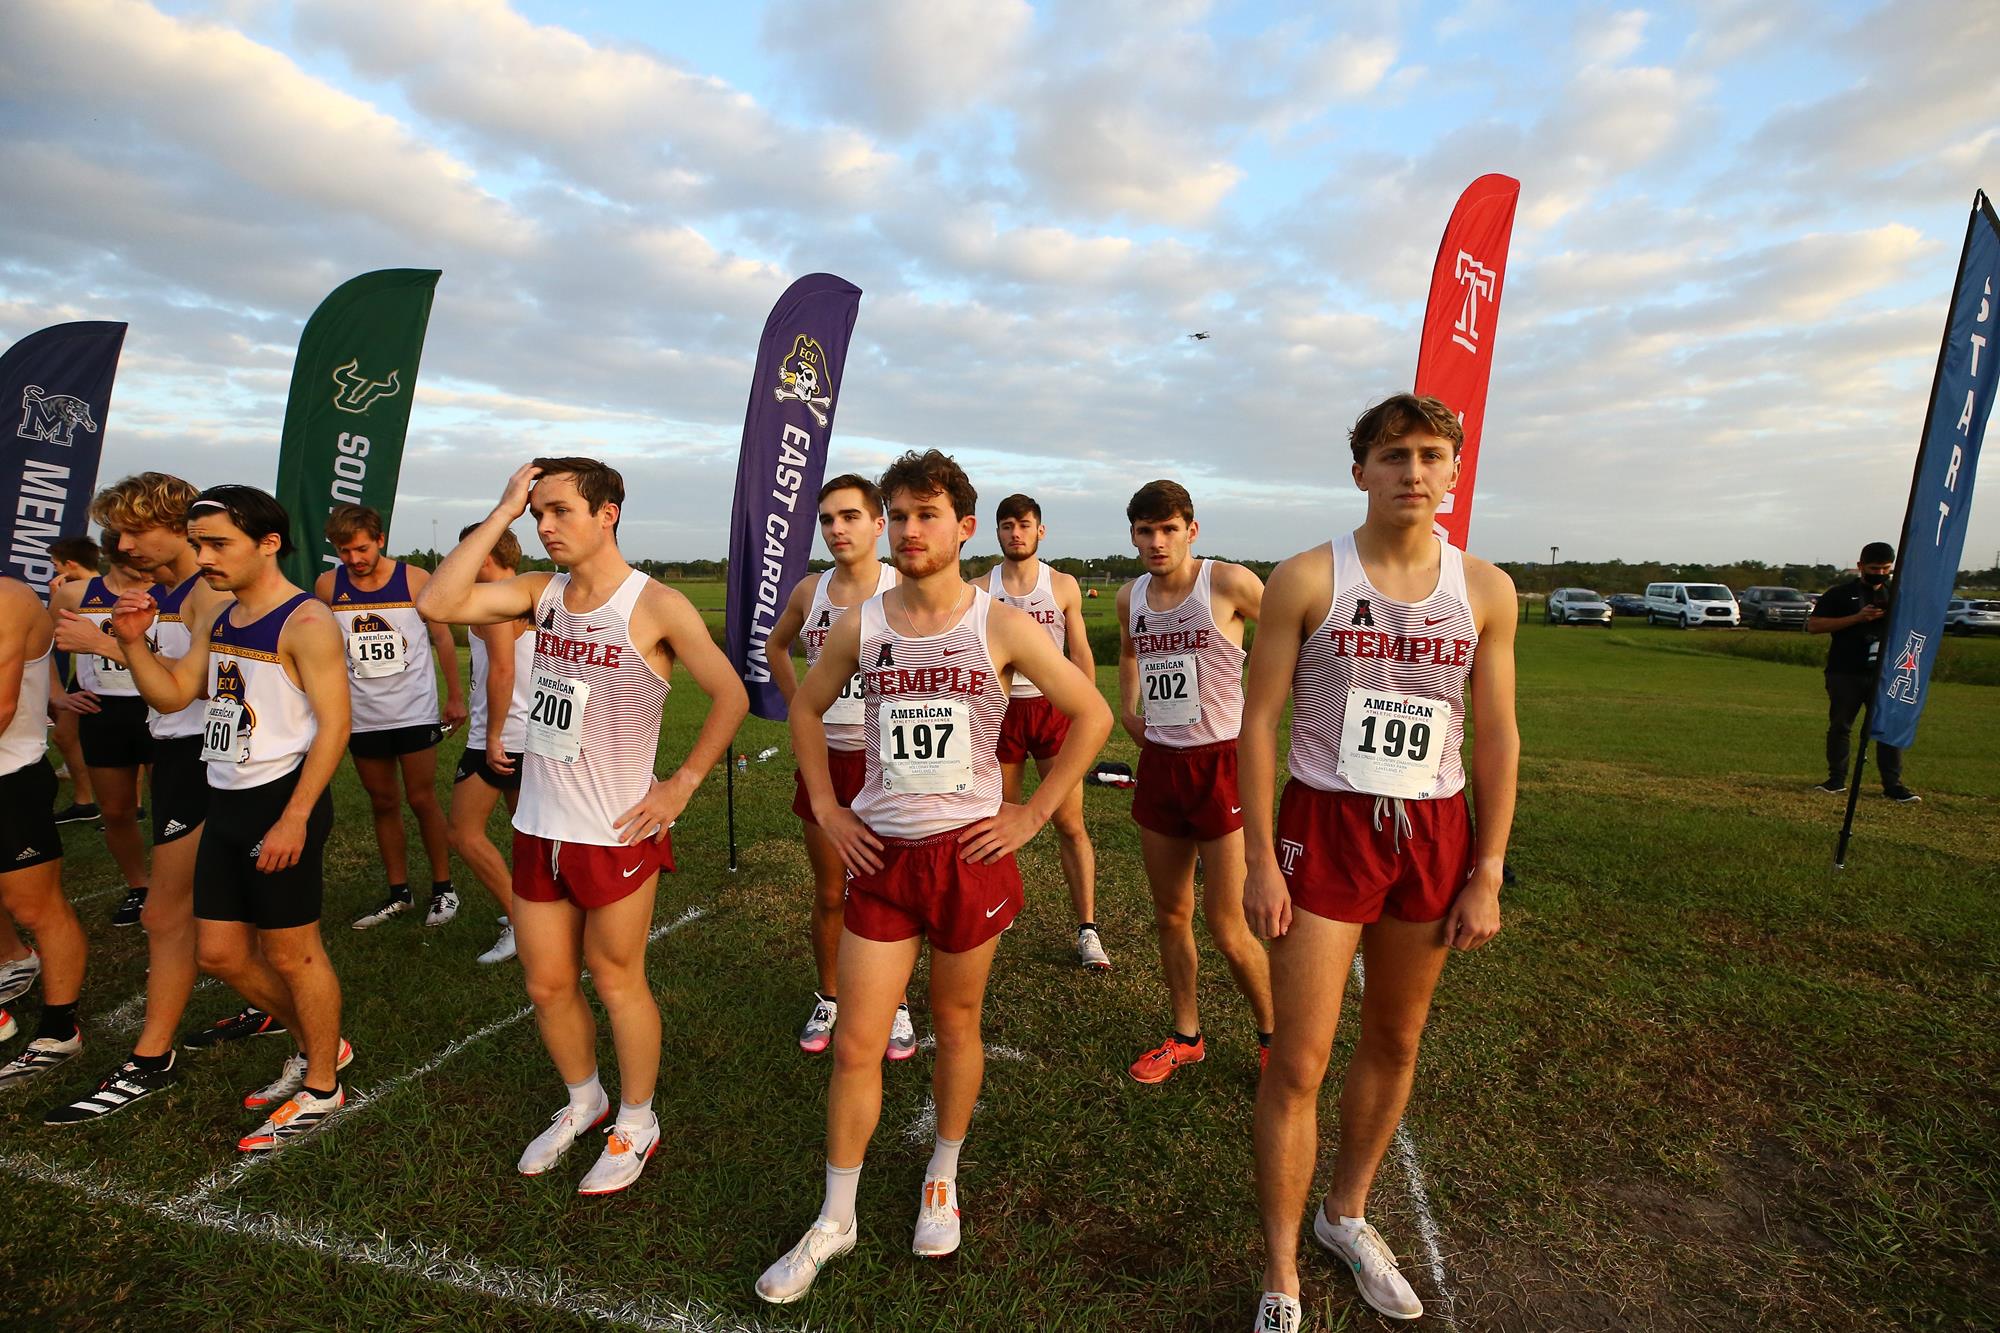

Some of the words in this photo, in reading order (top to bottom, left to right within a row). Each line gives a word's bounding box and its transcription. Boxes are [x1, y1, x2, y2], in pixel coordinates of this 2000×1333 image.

[799, 346, 819, 365] ECU
[1936, 275, 1991, 546] START
[329, 432, 370, 512] SOU
[772, 423, 811, 513] EAST
[9, 459, 70, 597] MEMP
[745, 513, 790, 684] CAROLINA
[358, 634, 394, 642] AMERICAN
[359, 622, 379, 632] ECU
[358, 642, 395, 661] 158
[1330, 630, 1471, 666] TEMPLE
[1145, 660, 1184, 671] AMERICAN
[217, 677, 238, 690] ECU
[537, 676, 575, 695] AMERICAN
[840, 674, 866, 699] 03
[865, 667, 987, 696] TEMPLE
[1146, 672, 1188, 700] 202
[530, 690, 573, 731] 200
[890, 705, 953, 719] AMERICAN
[1363, 697, 1434, 718] AMERICAN
[204, 720, 231, 752] 160
[892, 723, 954, 760] 197
[1357, 715, 1431, 762] 199
[956, 783, 966, 791] 197
